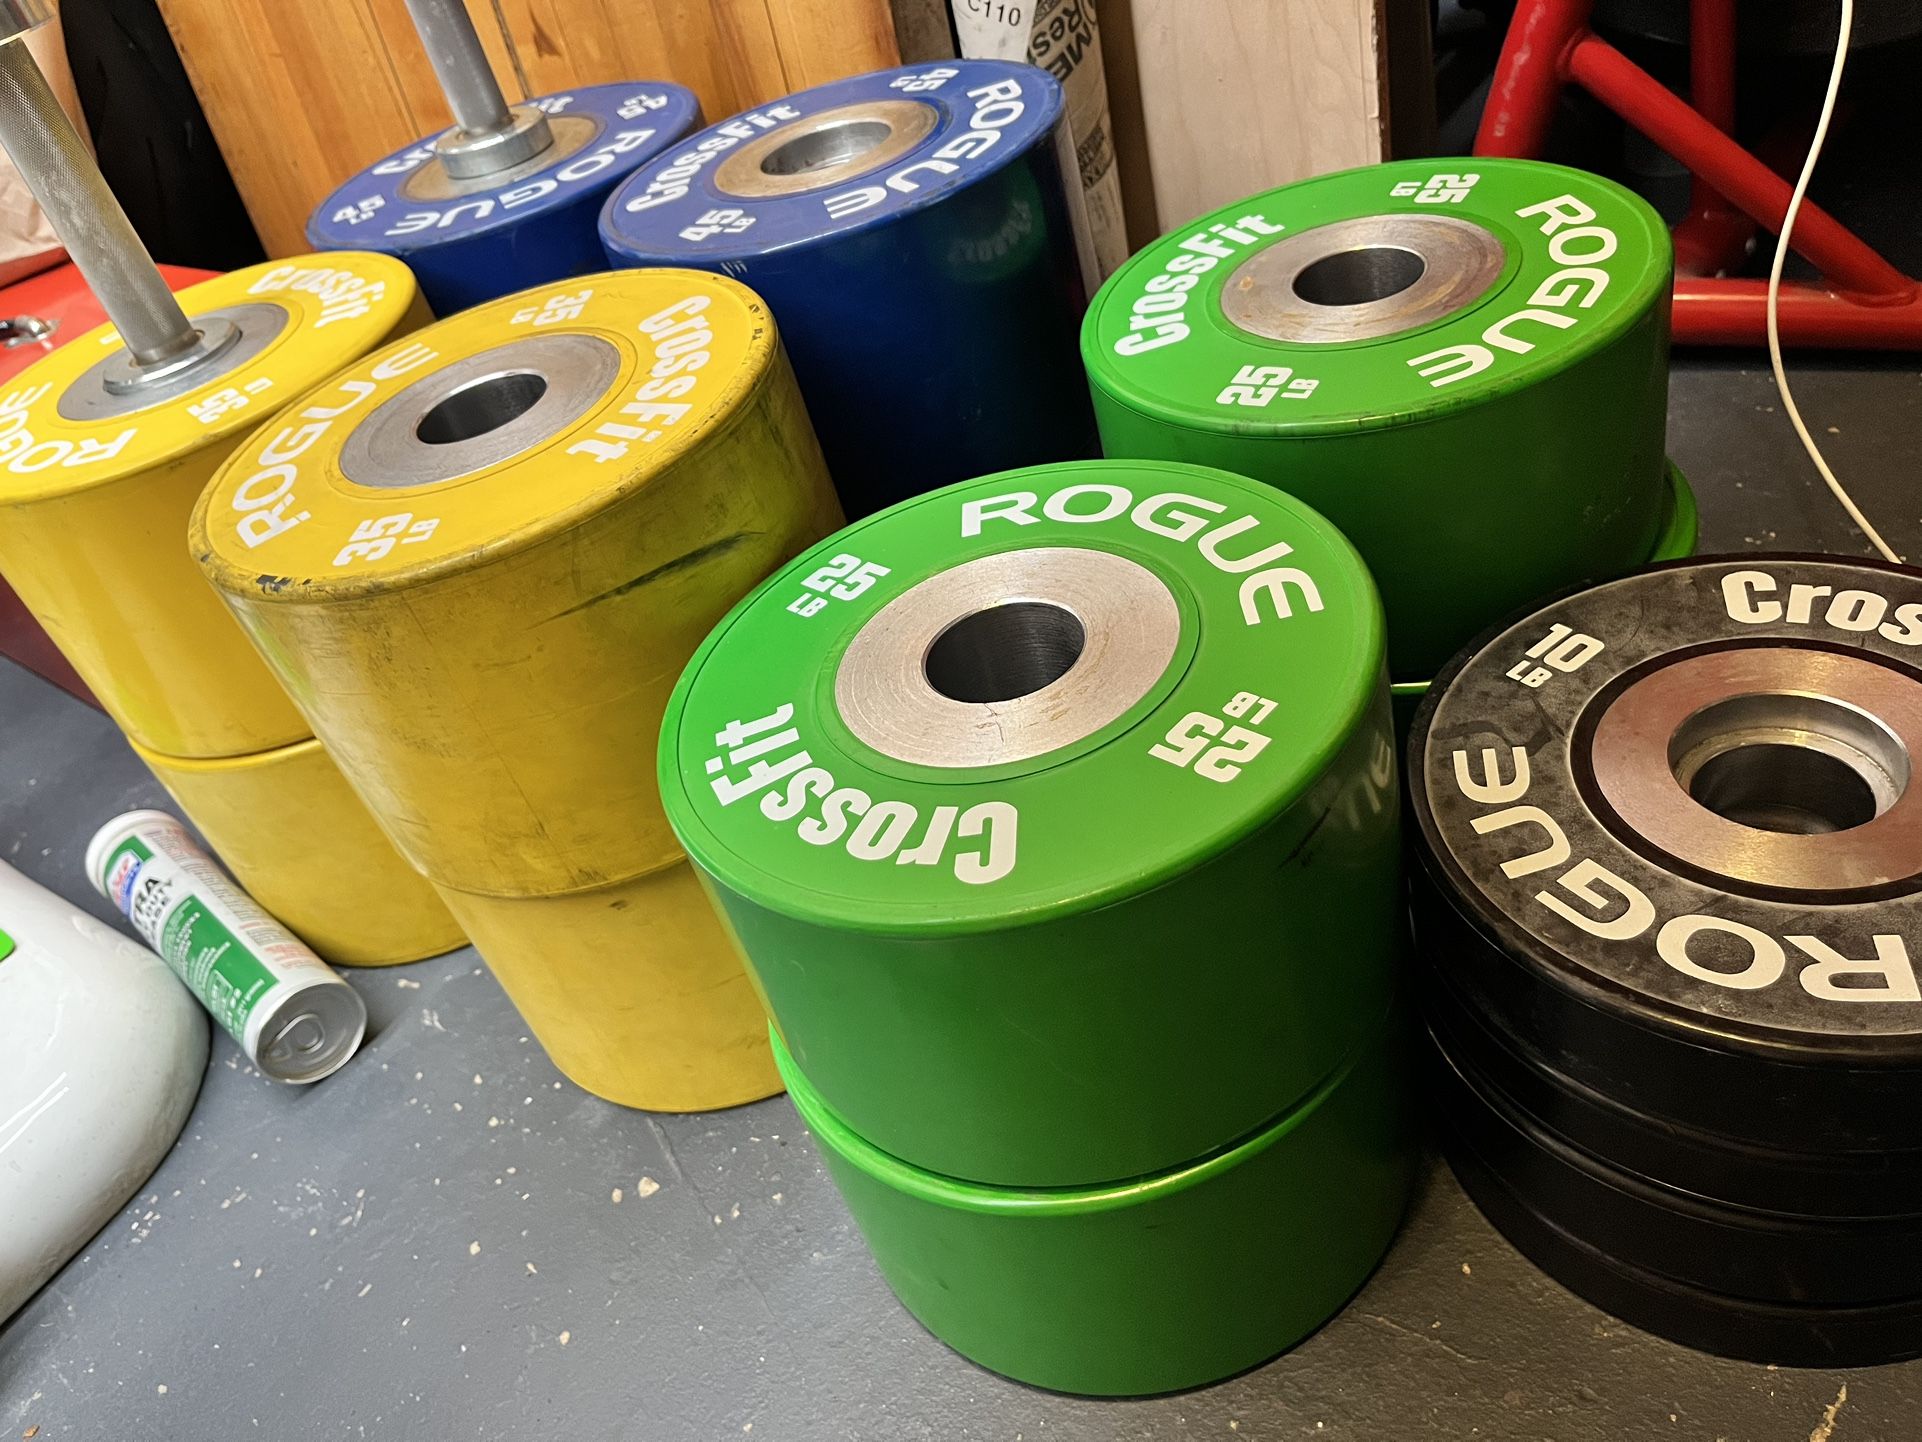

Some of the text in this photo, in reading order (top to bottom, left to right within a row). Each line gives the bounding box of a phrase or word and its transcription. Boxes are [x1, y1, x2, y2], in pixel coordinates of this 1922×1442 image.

[1027, 0, 1082, 64] Res
[902, 68, 960, 92] 45
[625, 104, 802, 213] CrossFit
[823, 78, 1025, 220] ROGUE
[332, 193, 386, 223] 45
[384, 128, 656, 237] ROGUE
[1389, 181, 1423, 197] LB
[1413, 173, 1481, 204] 25
[678, 208, 745, 242] 45
[722, 216, 757, 233] LB
[247, 265, 385, 329] CrossFit
[532, 288, 594, 327] 35
[1112, 213, 1286, 357] CrossFit
[1405, 193, 1618, 388] ROGUE
[566, 294, 715, 463] CrossFit
[1215, 364, 1294, 408] 25
[1280, 376, 1320, 399] LB
[231, 342, 440, 549] ROGUE
[331, 511, 414, 567] 35
[400, 517, 441, 545] LB
[960, 483, 1325, 626] ROGUE
[801, 552, 892, 602] 25
[785, 593, 829, 618] LB
[1523, 622, 1605, 673] 10
[1505, 659, 1553, 688] LB
[1221, 691, 1279, 726] LB
[1147, 711, 1273, 784] 25
[703, 702, 1019, 885] CrossFit
[1452, 745, 1922, 1002] ROGUE
